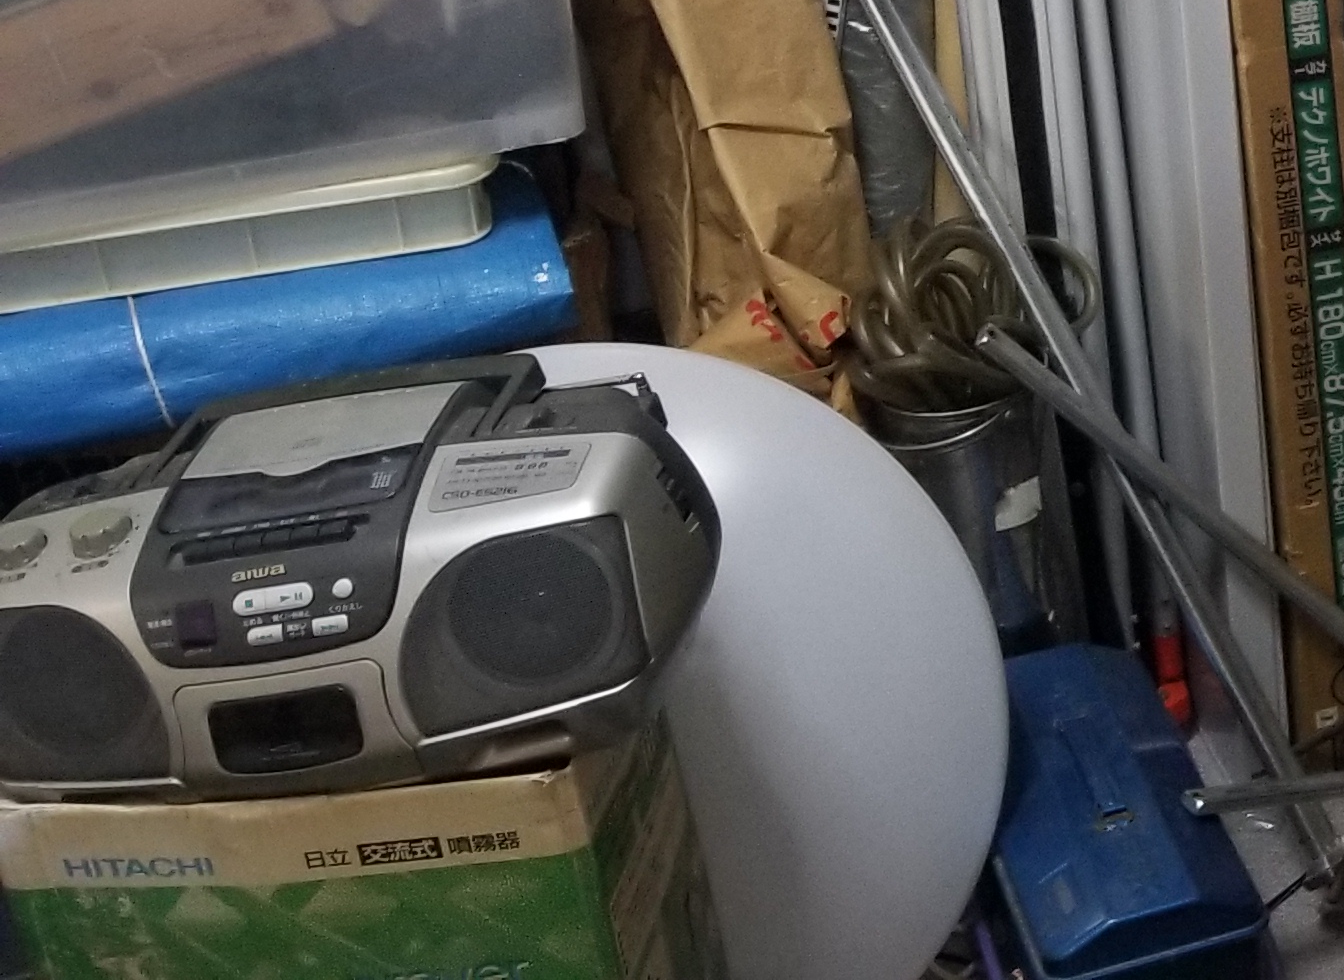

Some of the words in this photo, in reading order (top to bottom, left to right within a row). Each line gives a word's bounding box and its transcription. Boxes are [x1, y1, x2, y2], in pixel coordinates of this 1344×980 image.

[1297, 86, 1337, 223] テクノホワイト
[230, 563, 286, 583] aiwa
[62, 857, 215, 879] HITACHI
[305, 847, 352, 869] 日立
